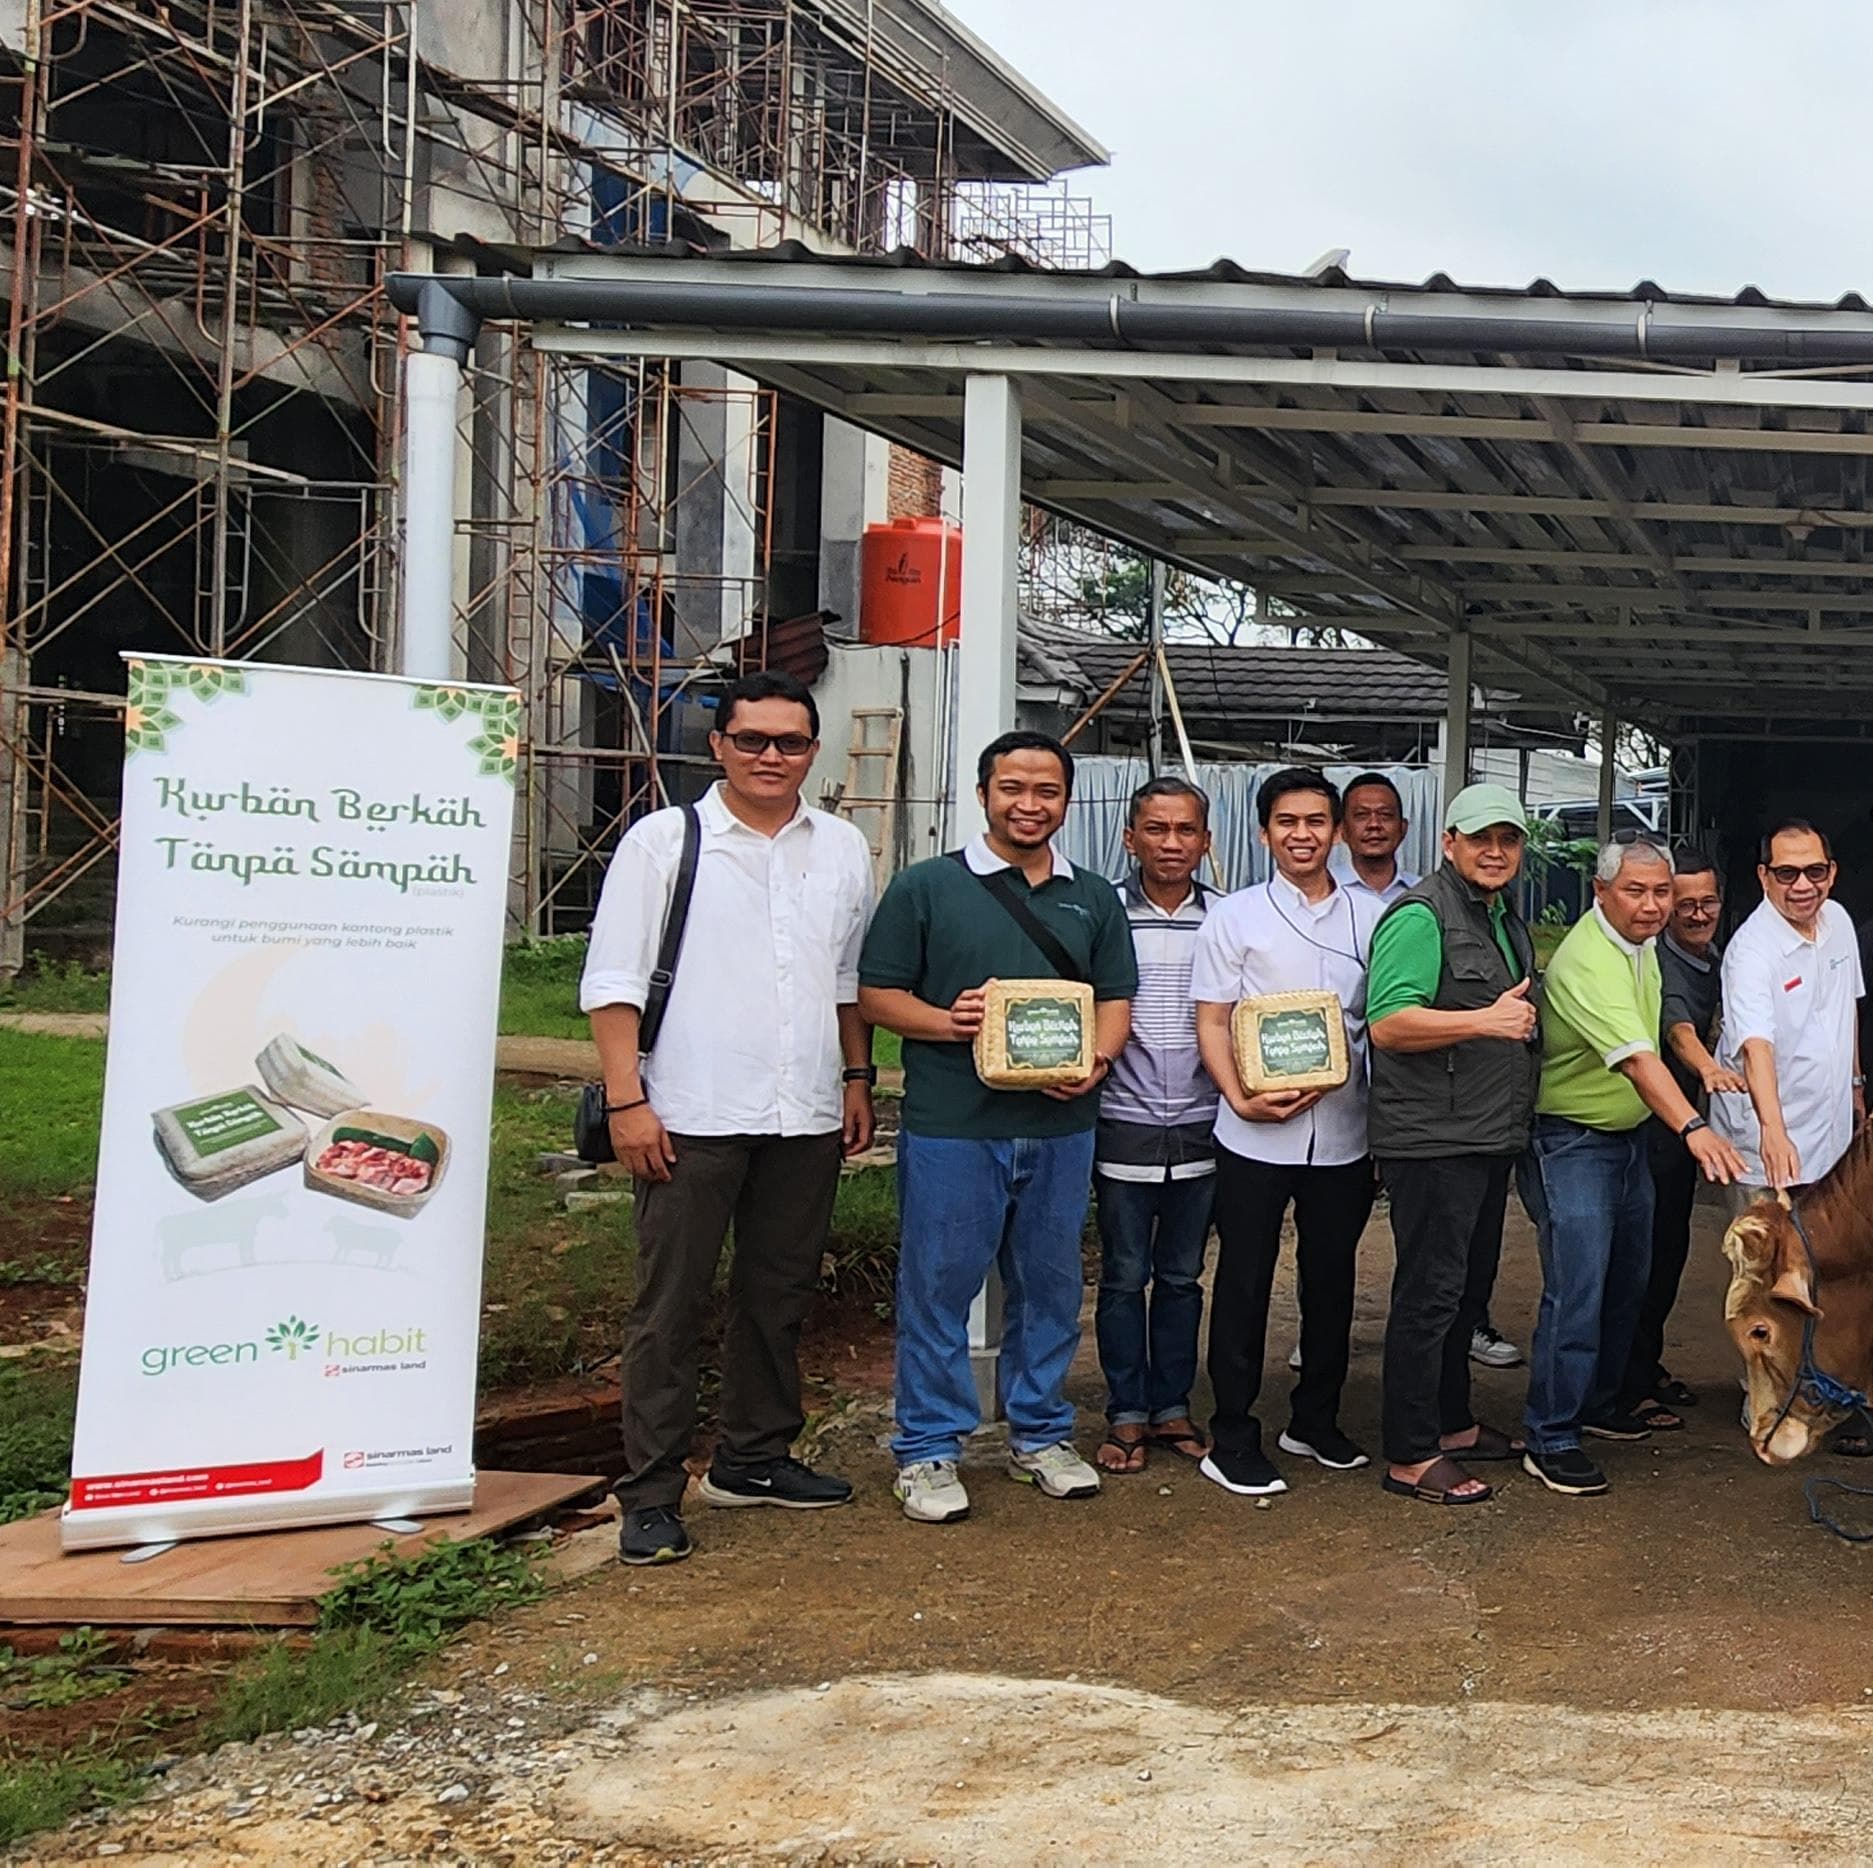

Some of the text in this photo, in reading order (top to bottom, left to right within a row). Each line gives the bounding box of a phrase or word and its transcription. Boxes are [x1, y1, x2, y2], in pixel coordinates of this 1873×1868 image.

[412, 886, 464, 898] (plastik)
[173, 916, 454, 938] Kurangi penggunaan kantong plastik
[211, 933, 417, 950] untuk bumi yang lebih baik
[141, 1328, 427, 1376] green habit
[342, 1361, 427, 1374] sinarmas land
[366, 1445, 452, 1460] sinarmas land
